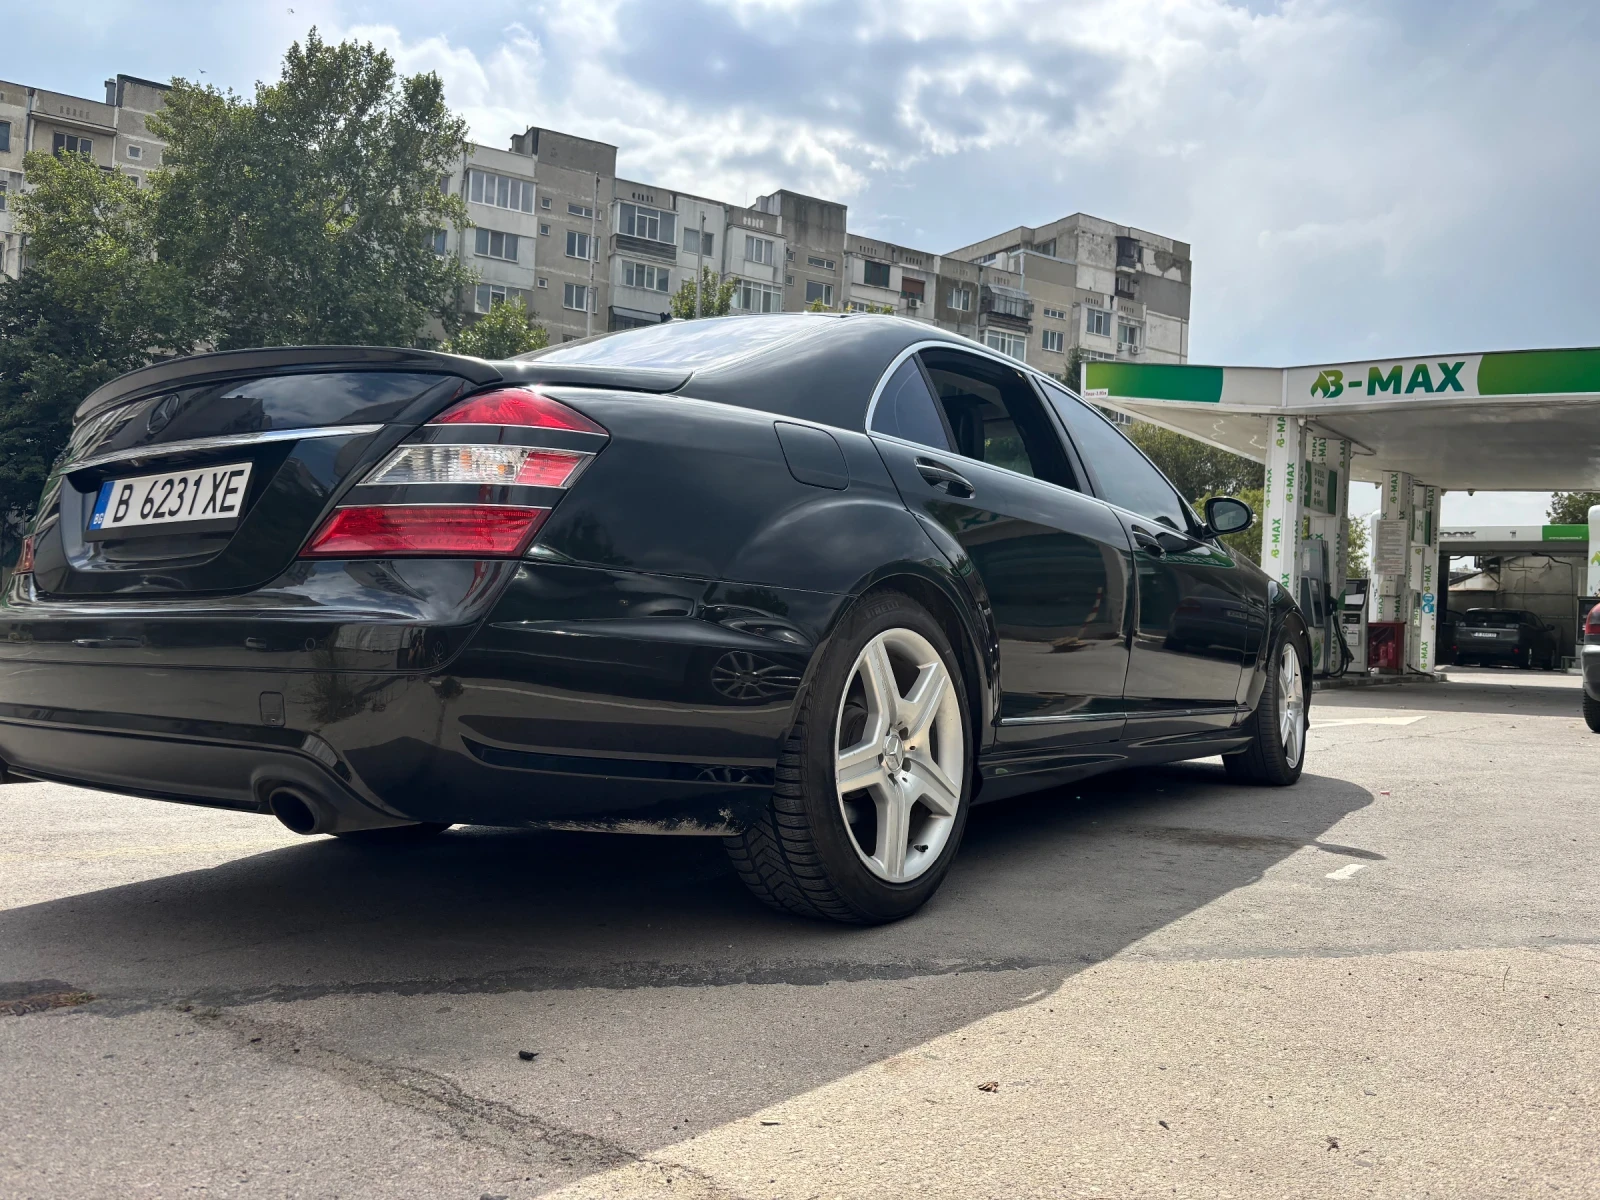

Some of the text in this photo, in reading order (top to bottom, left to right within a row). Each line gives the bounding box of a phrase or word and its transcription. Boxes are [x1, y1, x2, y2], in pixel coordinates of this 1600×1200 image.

[1310, 361, 1466, 398] B-MAX
[112, 469, 245, 523] B 6231 XE
[1286, 463, 1295, 503] B-MAX
[93, 513, 104, 525] BG
[1271, 518, 1281, 558] B-MAX
